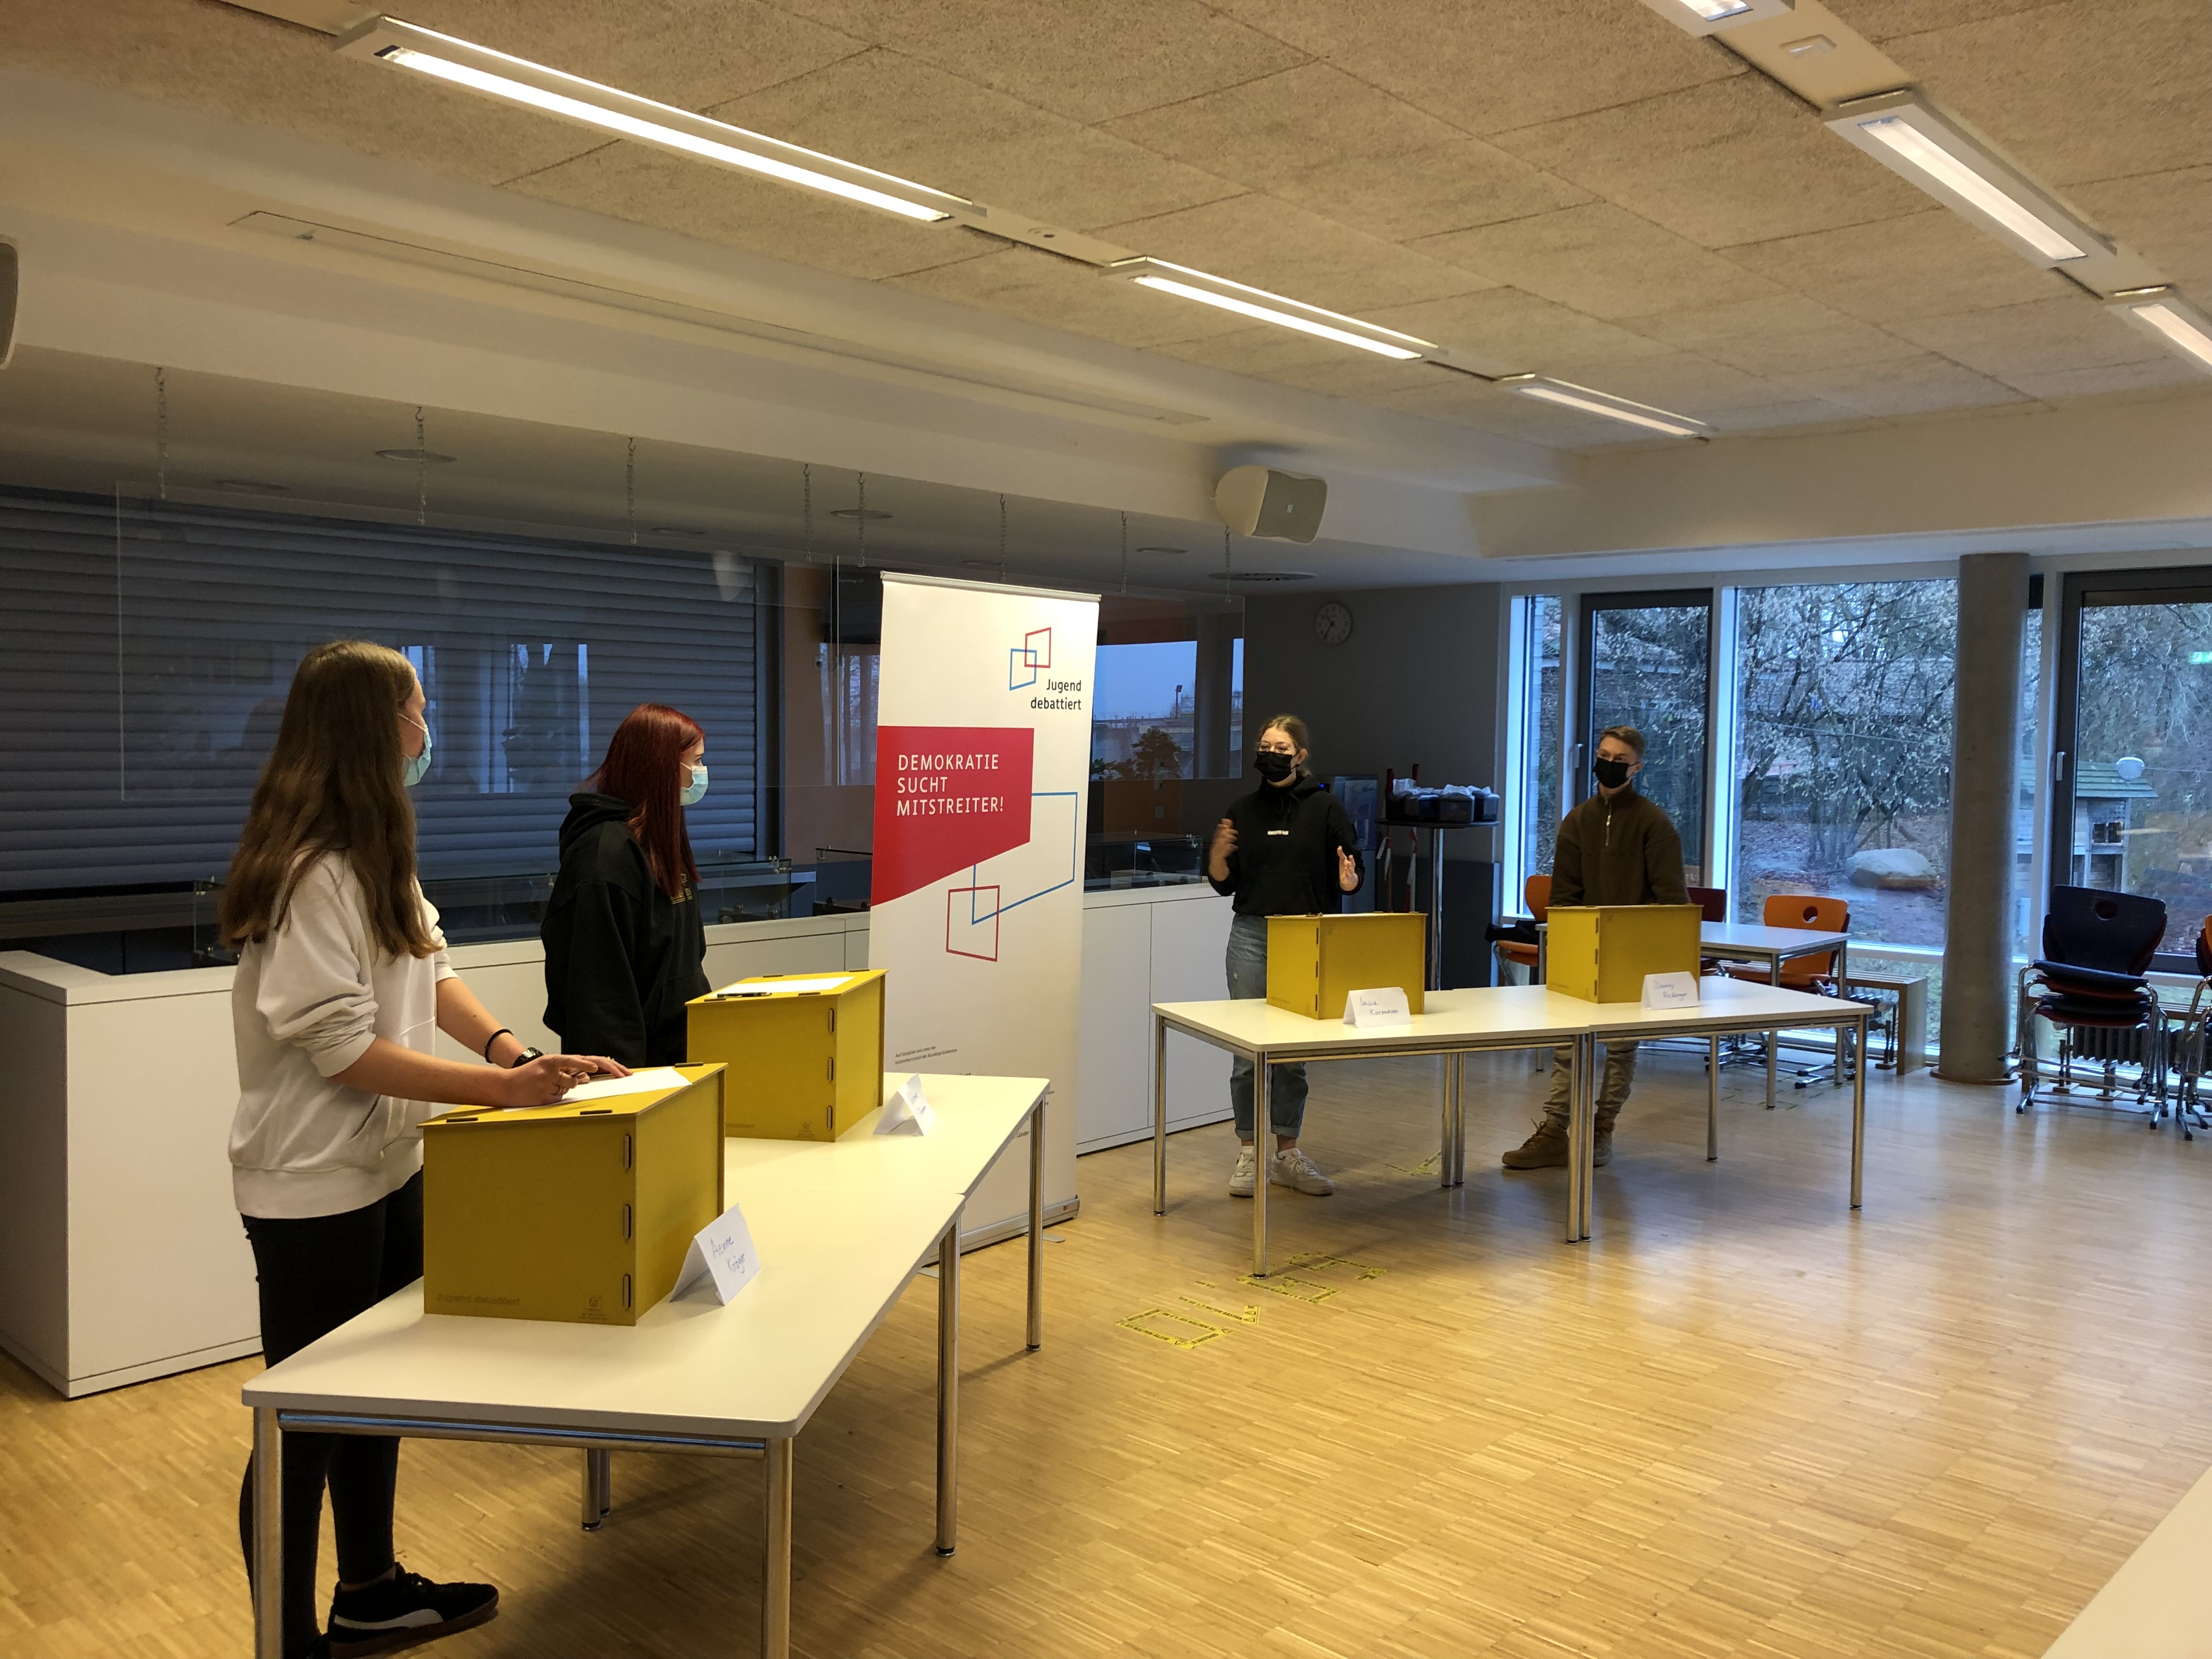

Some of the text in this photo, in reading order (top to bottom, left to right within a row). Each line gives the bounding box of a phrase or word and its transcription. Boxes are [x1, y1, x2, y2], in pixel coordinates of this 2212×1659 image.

[1046, 679, 1081, 693] Jugend
[1031, 696, 1081, 710] debattiert
[898, 754, 999, 771] DEMOKRATIE
[897, 776, 948, 793] SUCHT
[896, 796, 1004, 816] MITSTREITER!
